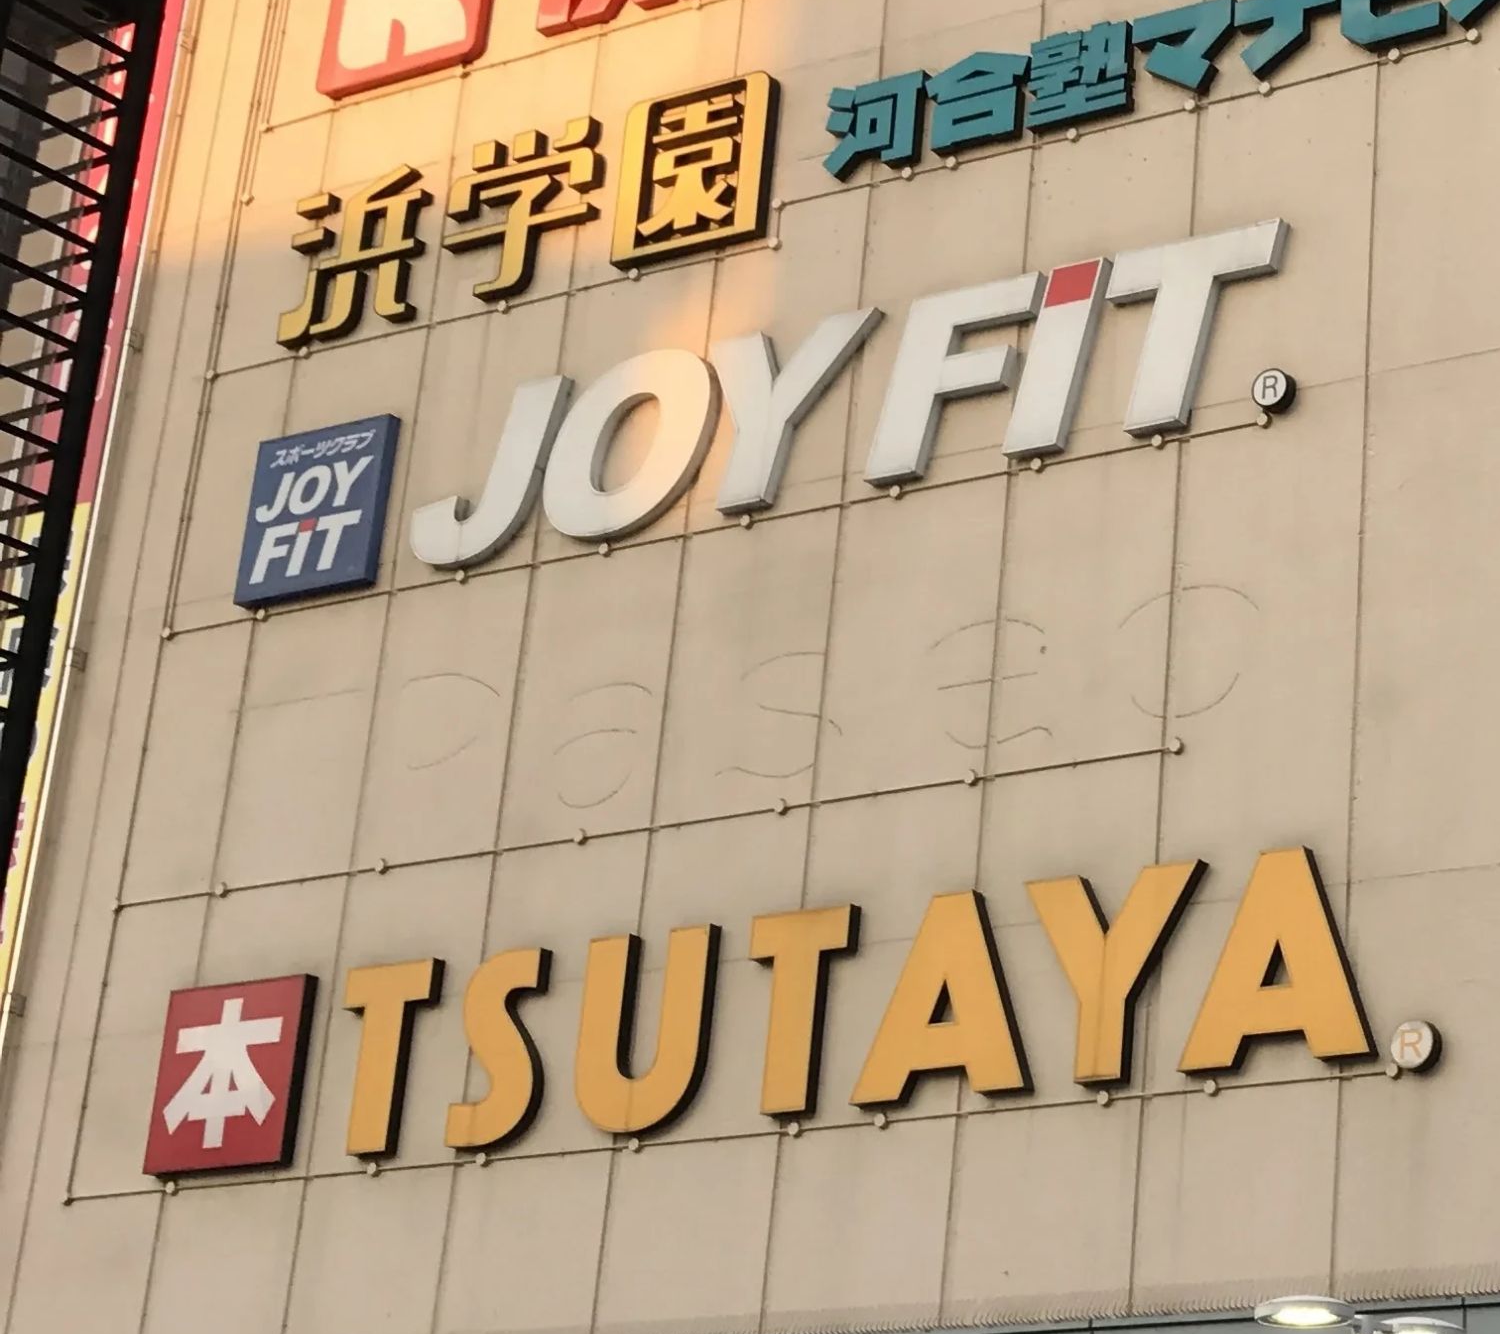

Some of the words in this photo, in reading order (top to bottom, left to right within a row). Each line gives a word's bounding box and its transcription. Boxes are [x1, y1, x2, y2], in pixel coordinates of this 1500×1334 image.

[276, 70, 782, 349] 浜学園
[255, 454, 375, 523] JOY
[270, 429, 377, 469] スポーツクラブ
[163, 998, 284, 1150] 本
[342, 845, 1379, 1160] TSUTAYA
